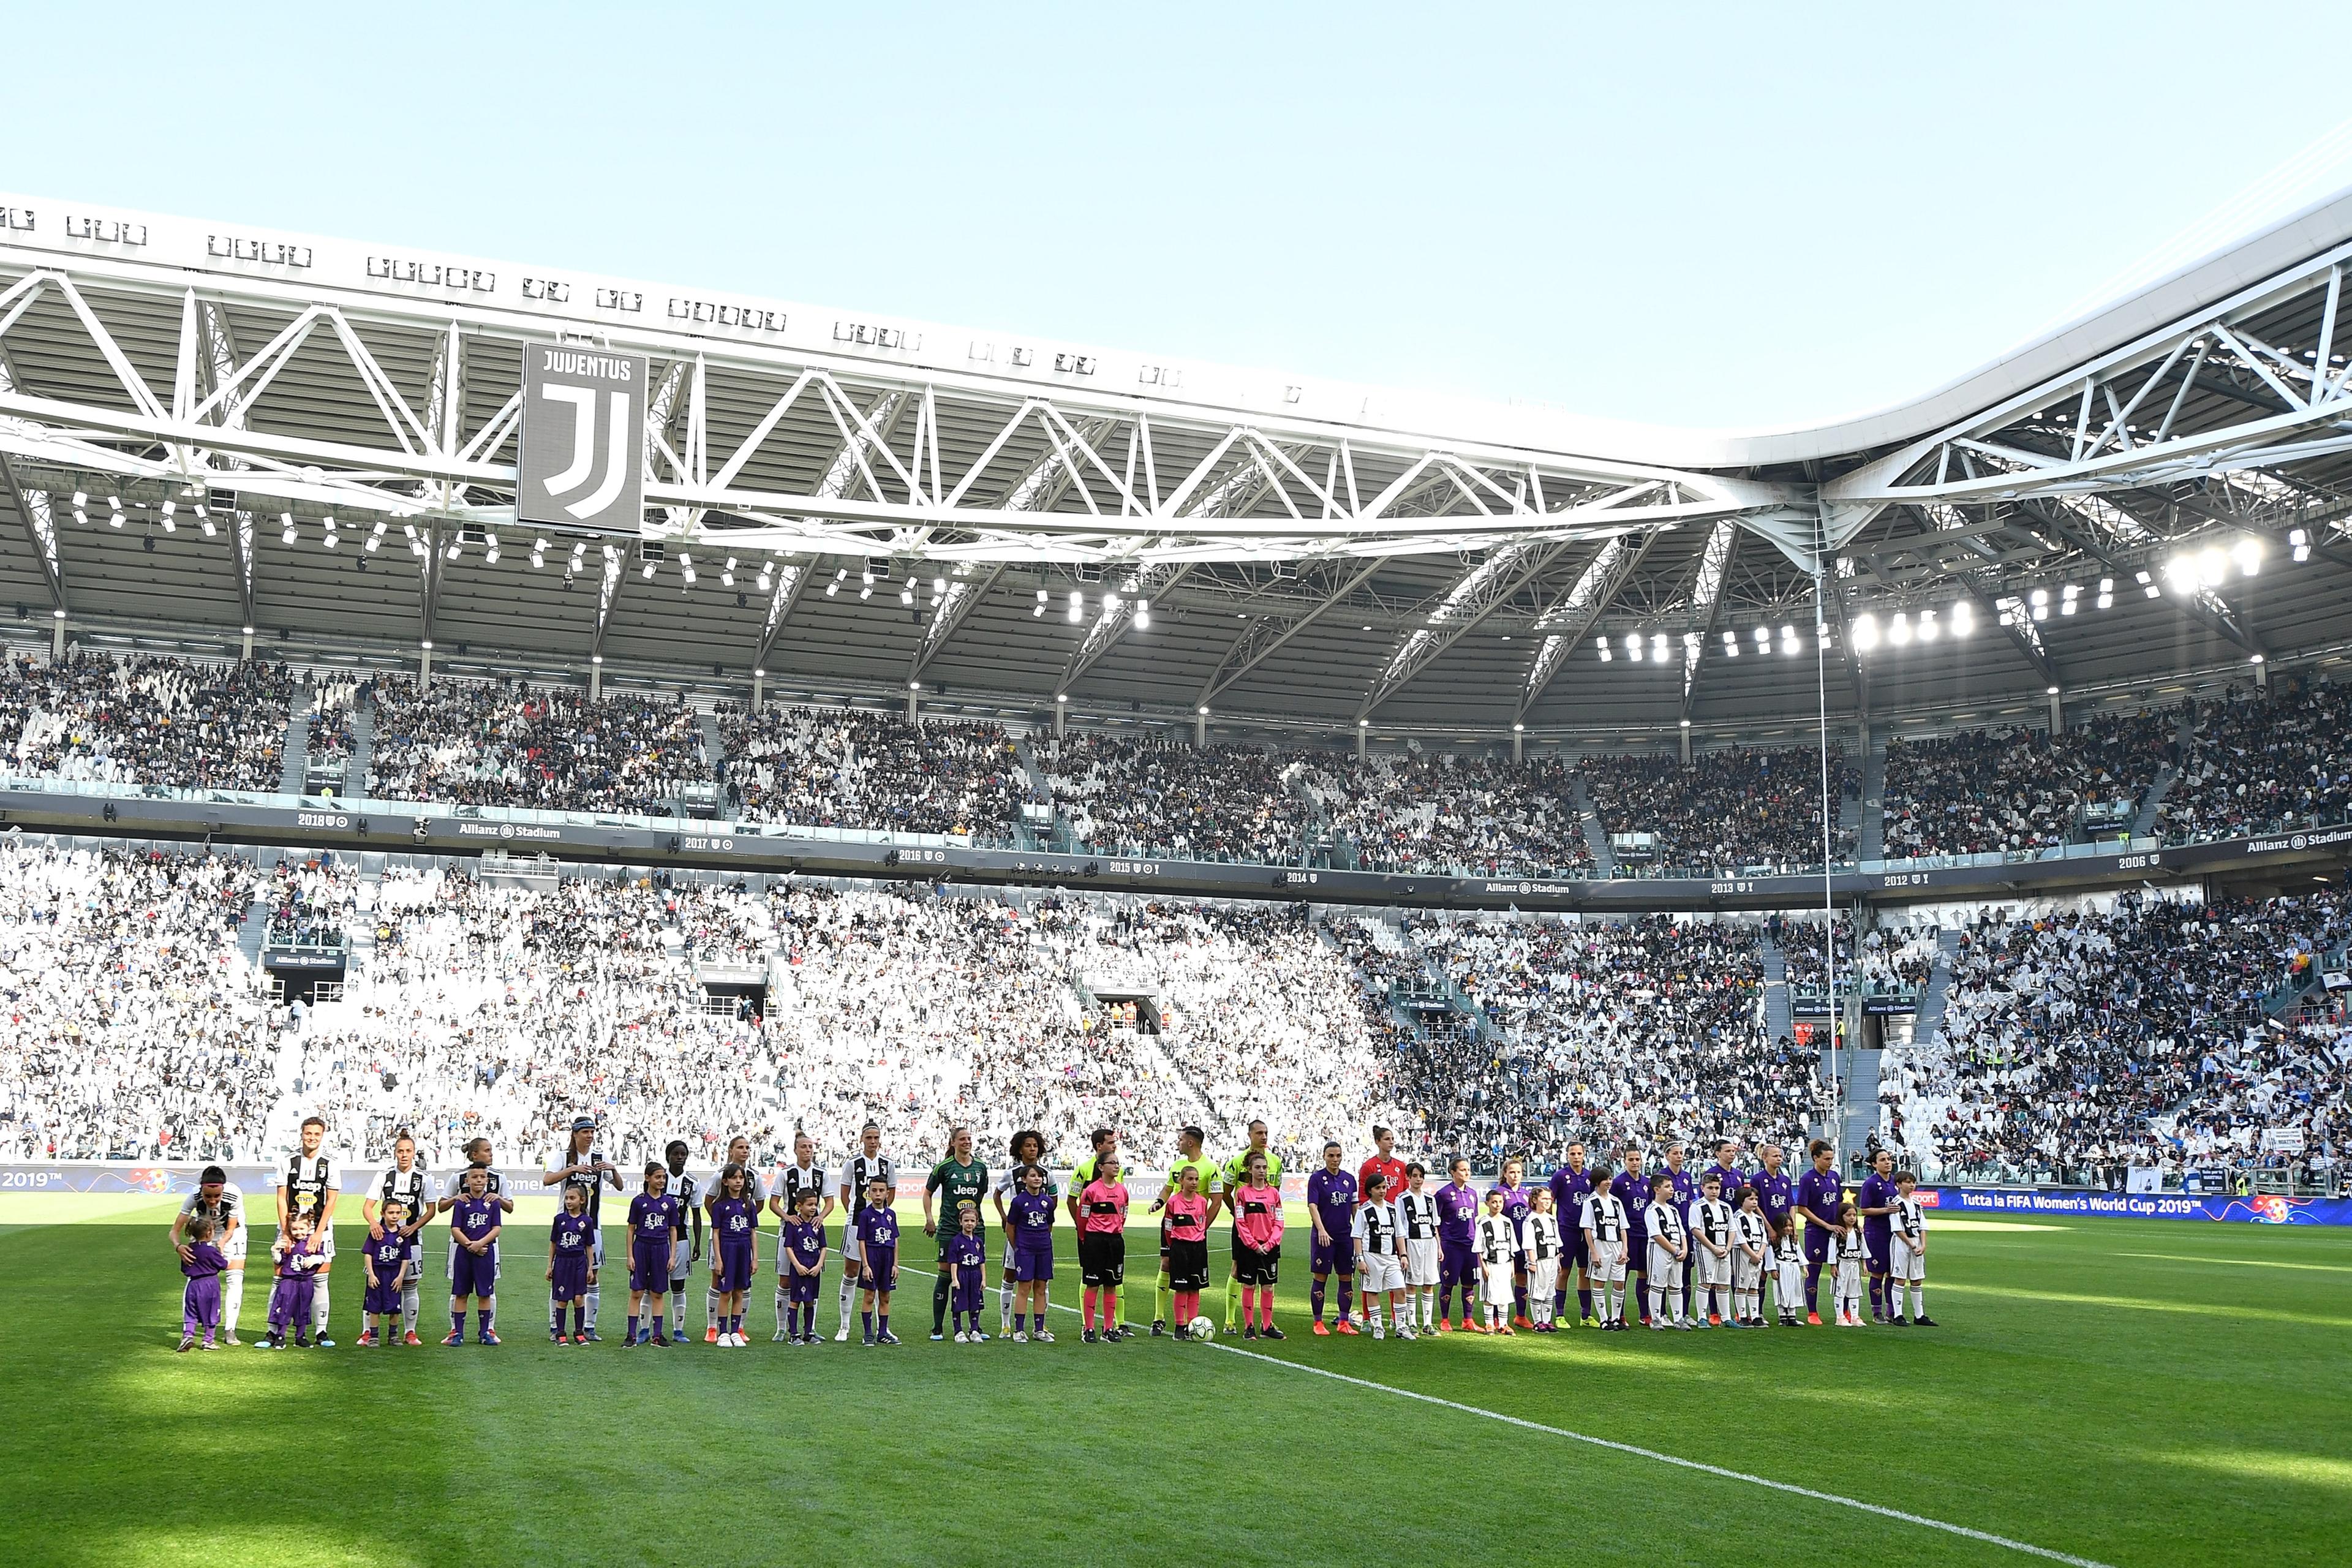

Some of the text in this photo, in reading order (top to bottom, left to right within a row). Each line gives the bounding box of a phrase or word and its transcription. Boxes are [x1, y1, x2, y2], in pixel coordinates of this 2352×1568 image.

[543, 350, 631, 381] JUVENTUS
[298, 813, 325, 826] 2018
[459, 824, 560, 839] Allianz Stadium
[685, 837, 708, 850] 2017
[2247, 830, 2352, 853] Allianz Stadium
[899, 850, 921, 861] 2016
[1110, 862, 1130, 873] 2015
[2119, 856, 2146, 869] 2006
[1287, 872, 1307, 883] 2014
[1885, 875, 1908, 886] 2012
[1485, 883, 1569, 894] Allianz Stadium
[1711, 883, 1733, 894] 2013
[571, 1172, 597, 1183] Jeep
[292, 1179, 322, 1193] Jeep
[953, 1185, 978, 1197] Jeep
[1961, 1194, 1991, 1206] Tutta
[1994, 1195, 2005, 1207] la
[2007, 1196, 2031, 1208] FIFA
[2034, 1196, 2087, 1210] Women's
[2089, 1197, 2127, 1212] World
[2129, 1199, 2155, 1215] Cup
[1412, 1214, 1433, 1224] Jeep
[1599, 1216, 1618, 1227] Jeep
[1374, 1225, 1394, 1235] Jeep
[1709, 1222, 1728, 1232] Jeep
[1777, 1251, 1796, 1261] Jeep
[1841, 1249, 1862, 1259] Jeep
[410, 1261, 422, 1276] 13
